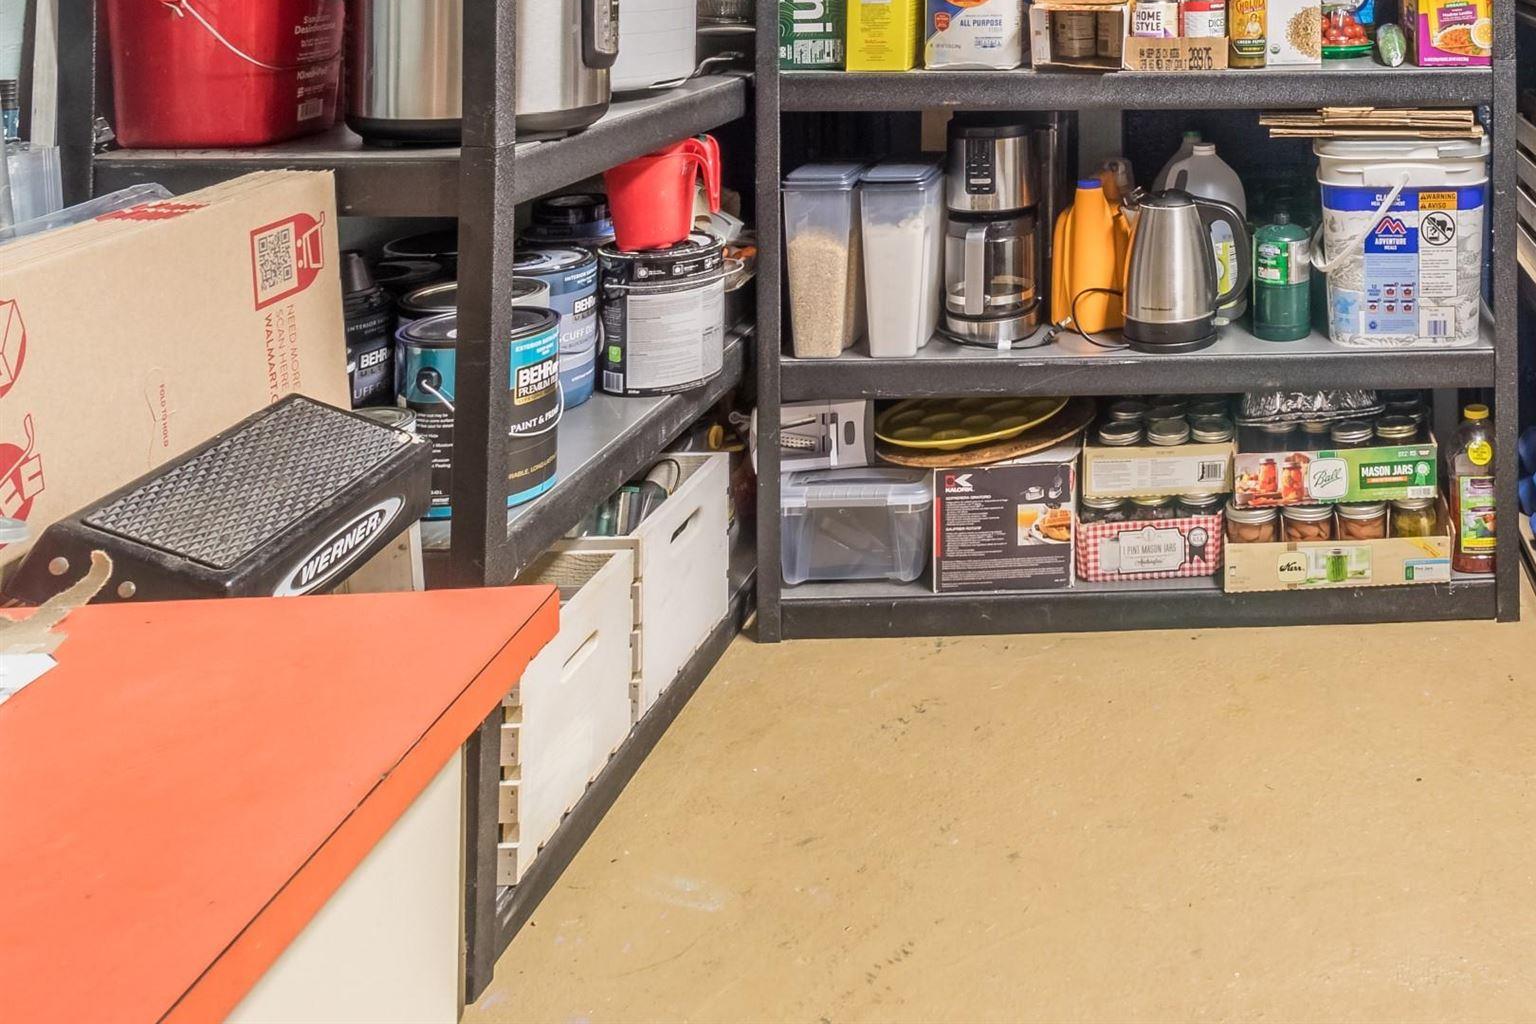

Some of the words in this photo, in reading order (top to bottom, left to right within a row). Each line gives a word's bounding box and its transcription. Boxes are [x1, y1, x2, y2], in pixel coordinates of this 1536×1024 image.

[960, 19, 970, 27] ALL
[972, 19, 1002, 27] PURPOSE
[1136, 11, 1161, 21] HOME
[1136, 21, 1161, 31] STYLE
[276, 309, 287, 349] SCAN
[287, 303, 296, 344] NEED
[290, 347, 301, 388] MORE
[360, 347, 388, 369] BEHR
[279, 351, 290, 392] HERE
[518, 360, 553, 388] BEHR
[510, 417, 537, 434] PAINT
[1314, 467, 1341, 488] Ball
[1361, 466, 1391, 477] MASON
[1393, 464, 1414, 475] JARS
[302, 511, 379, 585] WERNER
